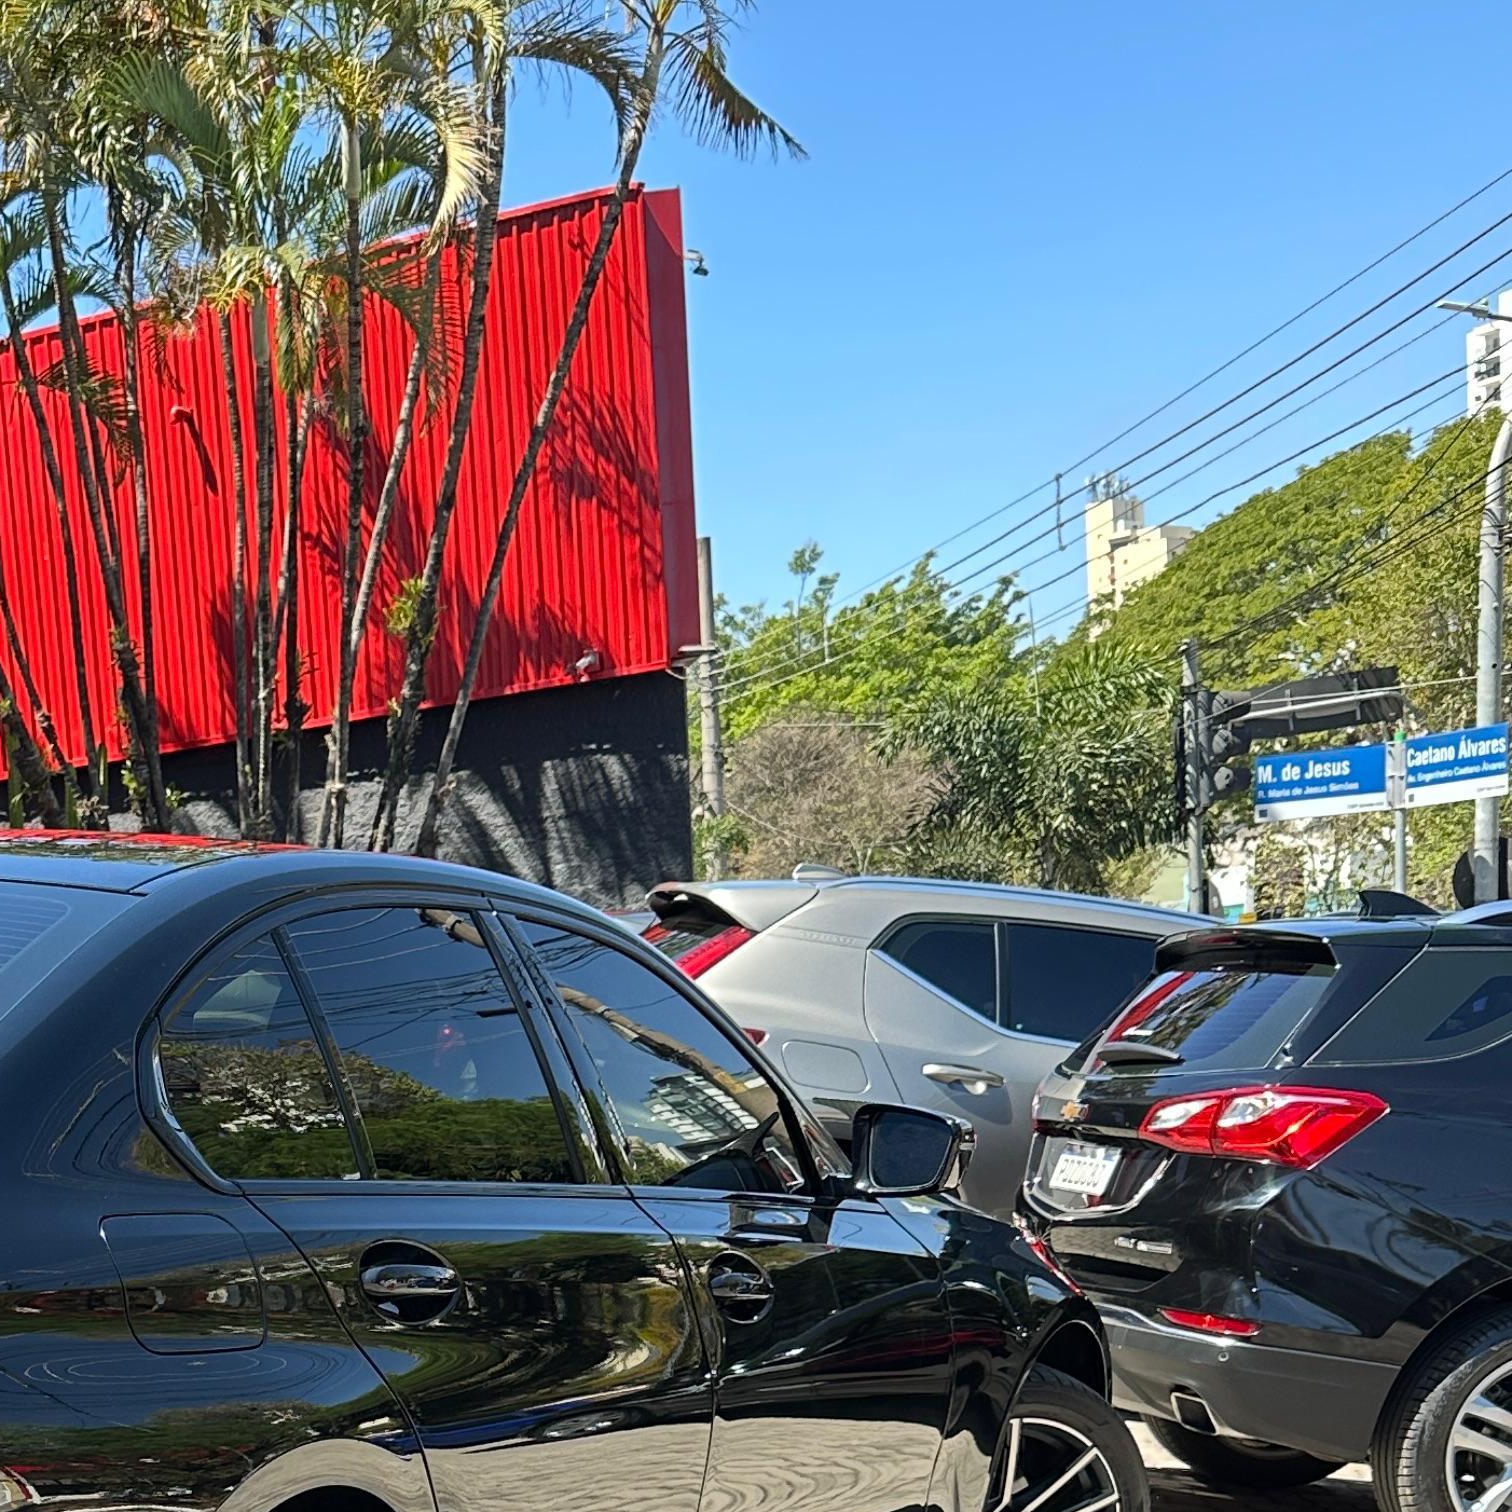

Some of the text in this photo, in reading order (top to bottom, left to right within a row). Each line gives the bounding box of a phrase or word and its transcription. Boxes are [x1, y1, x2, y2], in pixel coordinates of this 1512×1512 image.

[1407, 734, 1506, 768] Caetano Álvares
[1257, 759, 1351, 784] M. de Jesus
[1417, 769, 1453, 782] Engenheiro
[1454, 764, 1481, 775] Caetano
[1481, 760, 1506, 772] Álvares
[1291, 786, 1303, 796] de
[1304, 783, 1327, 795] Jesus
